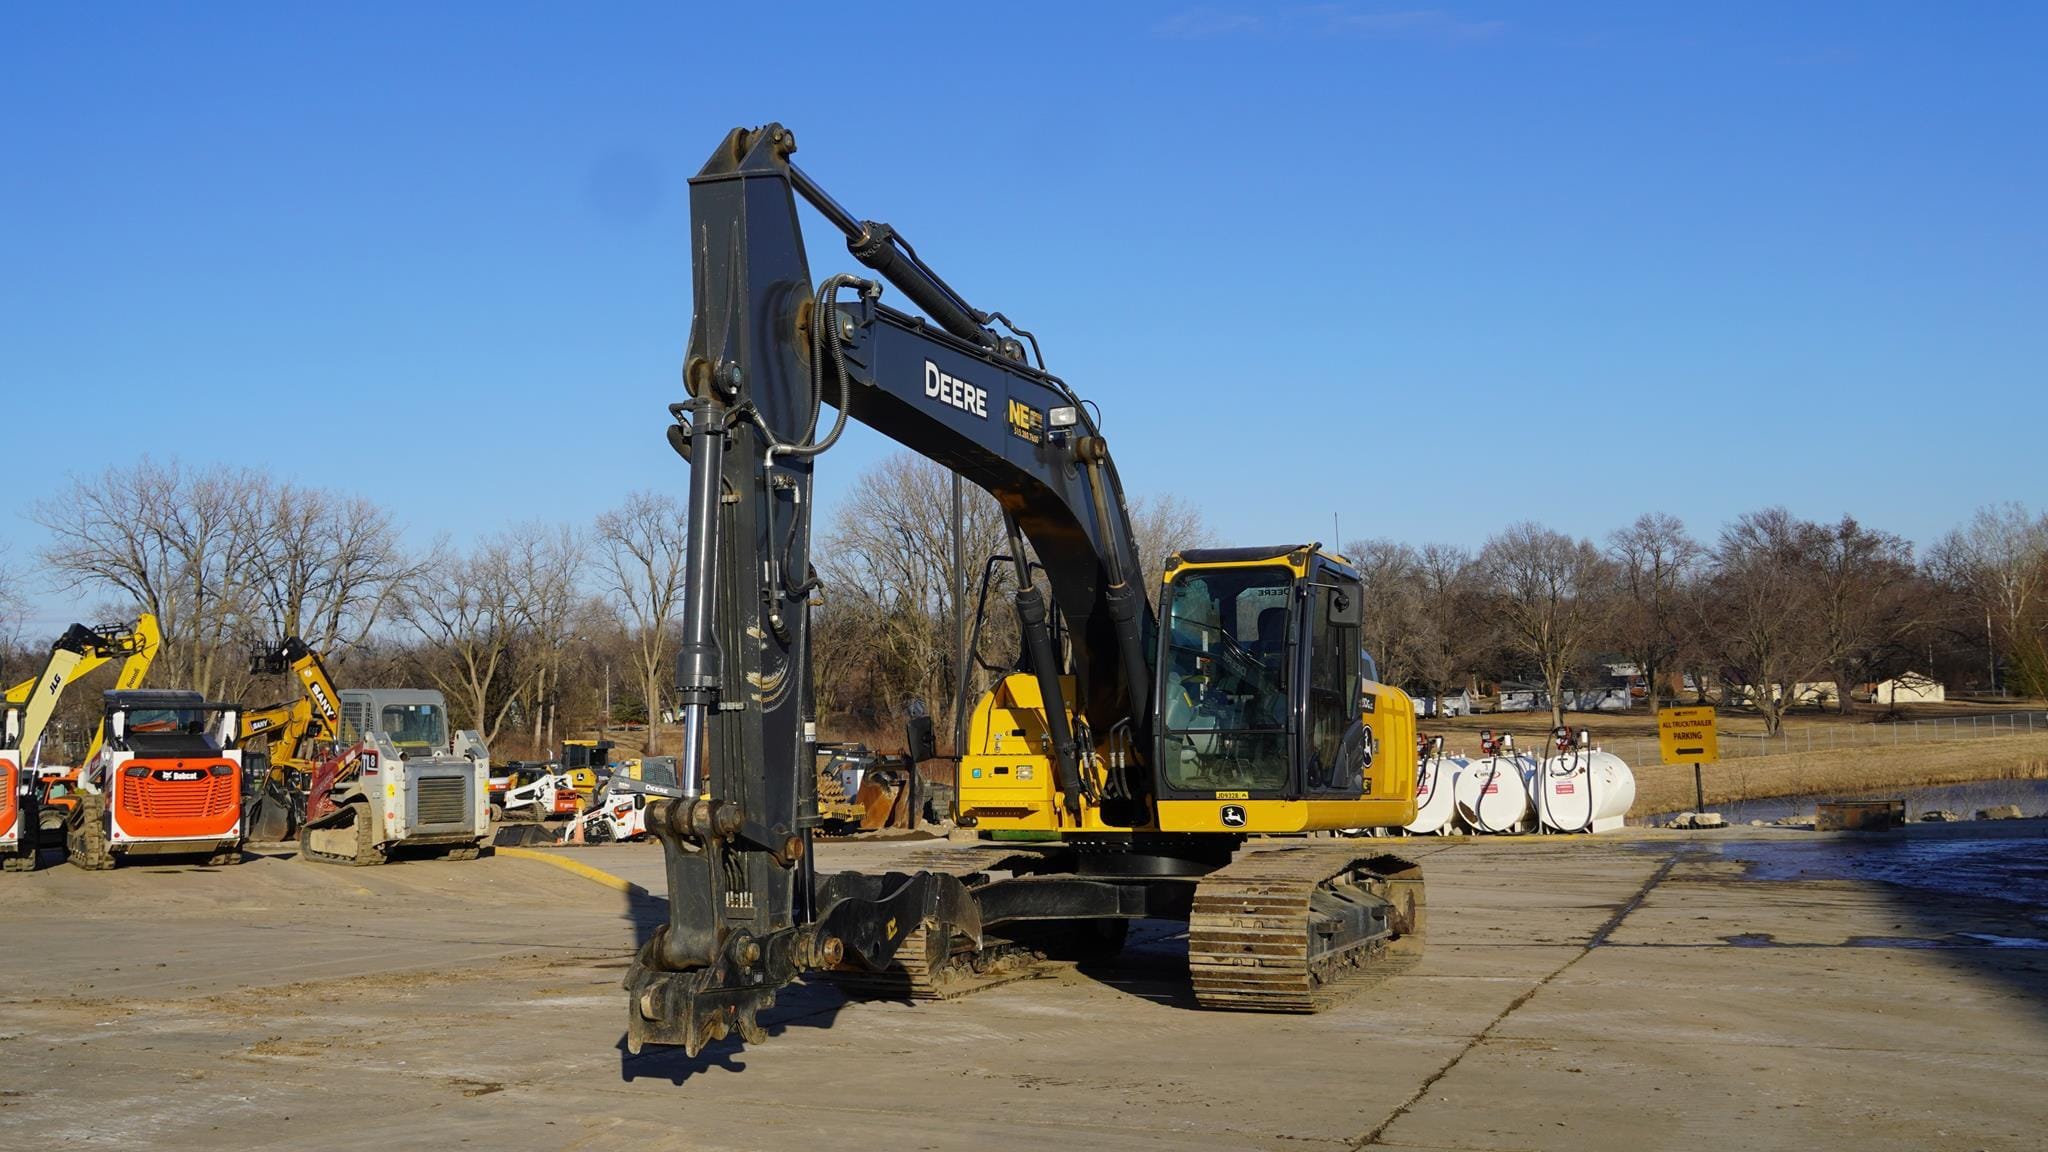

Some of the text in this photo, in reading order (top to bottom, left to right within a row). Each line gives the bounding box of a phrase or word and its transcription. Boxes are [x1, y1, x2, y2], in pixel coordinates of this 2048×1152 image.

[925, 360, 987, 418] DEERE
[1009, 399, 1030, 430] NE
[49, 673, 62, 695] JLG
[310, 683, 335, 717] SANY
[1673, 731, 1703, 741] PARKING
[173, 772, 198, 780] Bobcat
[645, 784, 669, 794] DEERE
